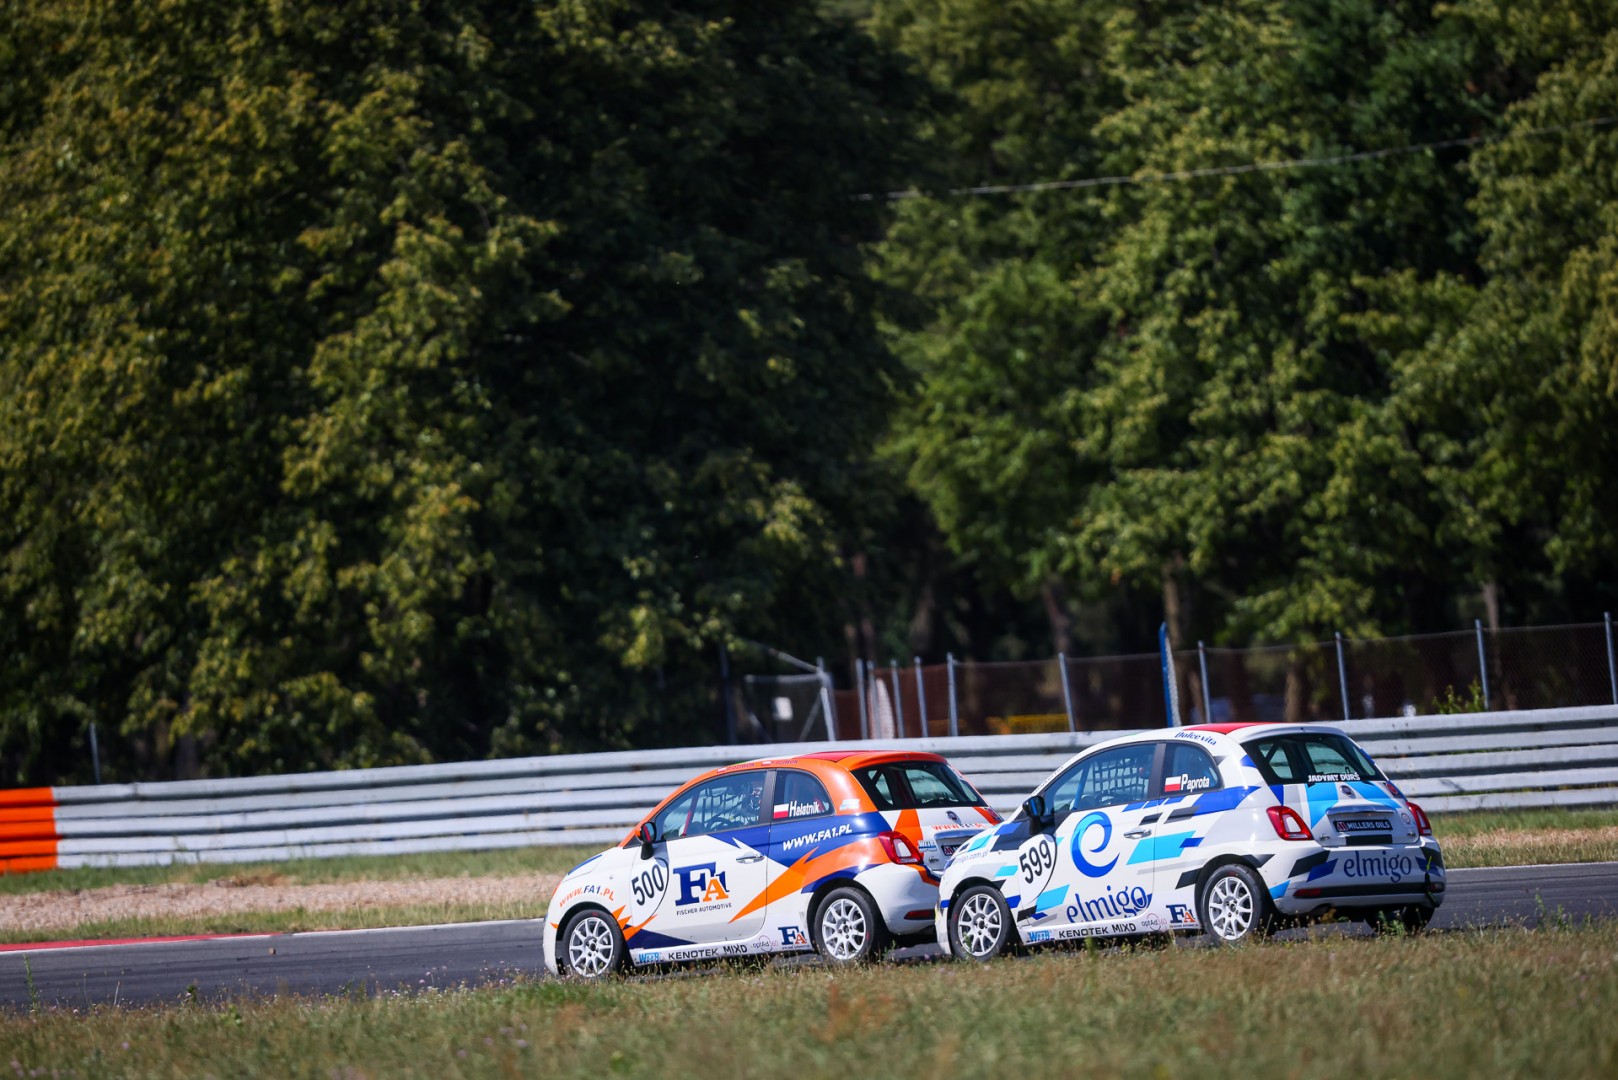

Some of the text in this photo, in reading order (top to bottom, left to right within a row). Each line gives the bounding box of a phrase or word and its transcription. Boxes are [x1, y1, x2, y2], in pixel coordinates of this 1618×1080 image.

[1200, 736, 1217, 745] vita
[1181, 773, 1210, 793] Paprota
[1347, 821, 1391, 830] MILLERS OILS
[782, 824, 853, 851] WWW.FA1.PL
[1019, 839, 1052, 884] 599
[1344, 851, 1412, 883] elmigo
[631, 864, 665, 906] 500
[676, 902, 732, 916] FISCHER AUTOMOTIVE
[1066, 885, 1149, 923] elmigo
[1058, 926, 1109, 939] KENOTEK
[1111, 922, 1137, 933] MIXD
[668, 948, 719, 961] KENOTEK
[722, 944, 748, 954] MIXD
